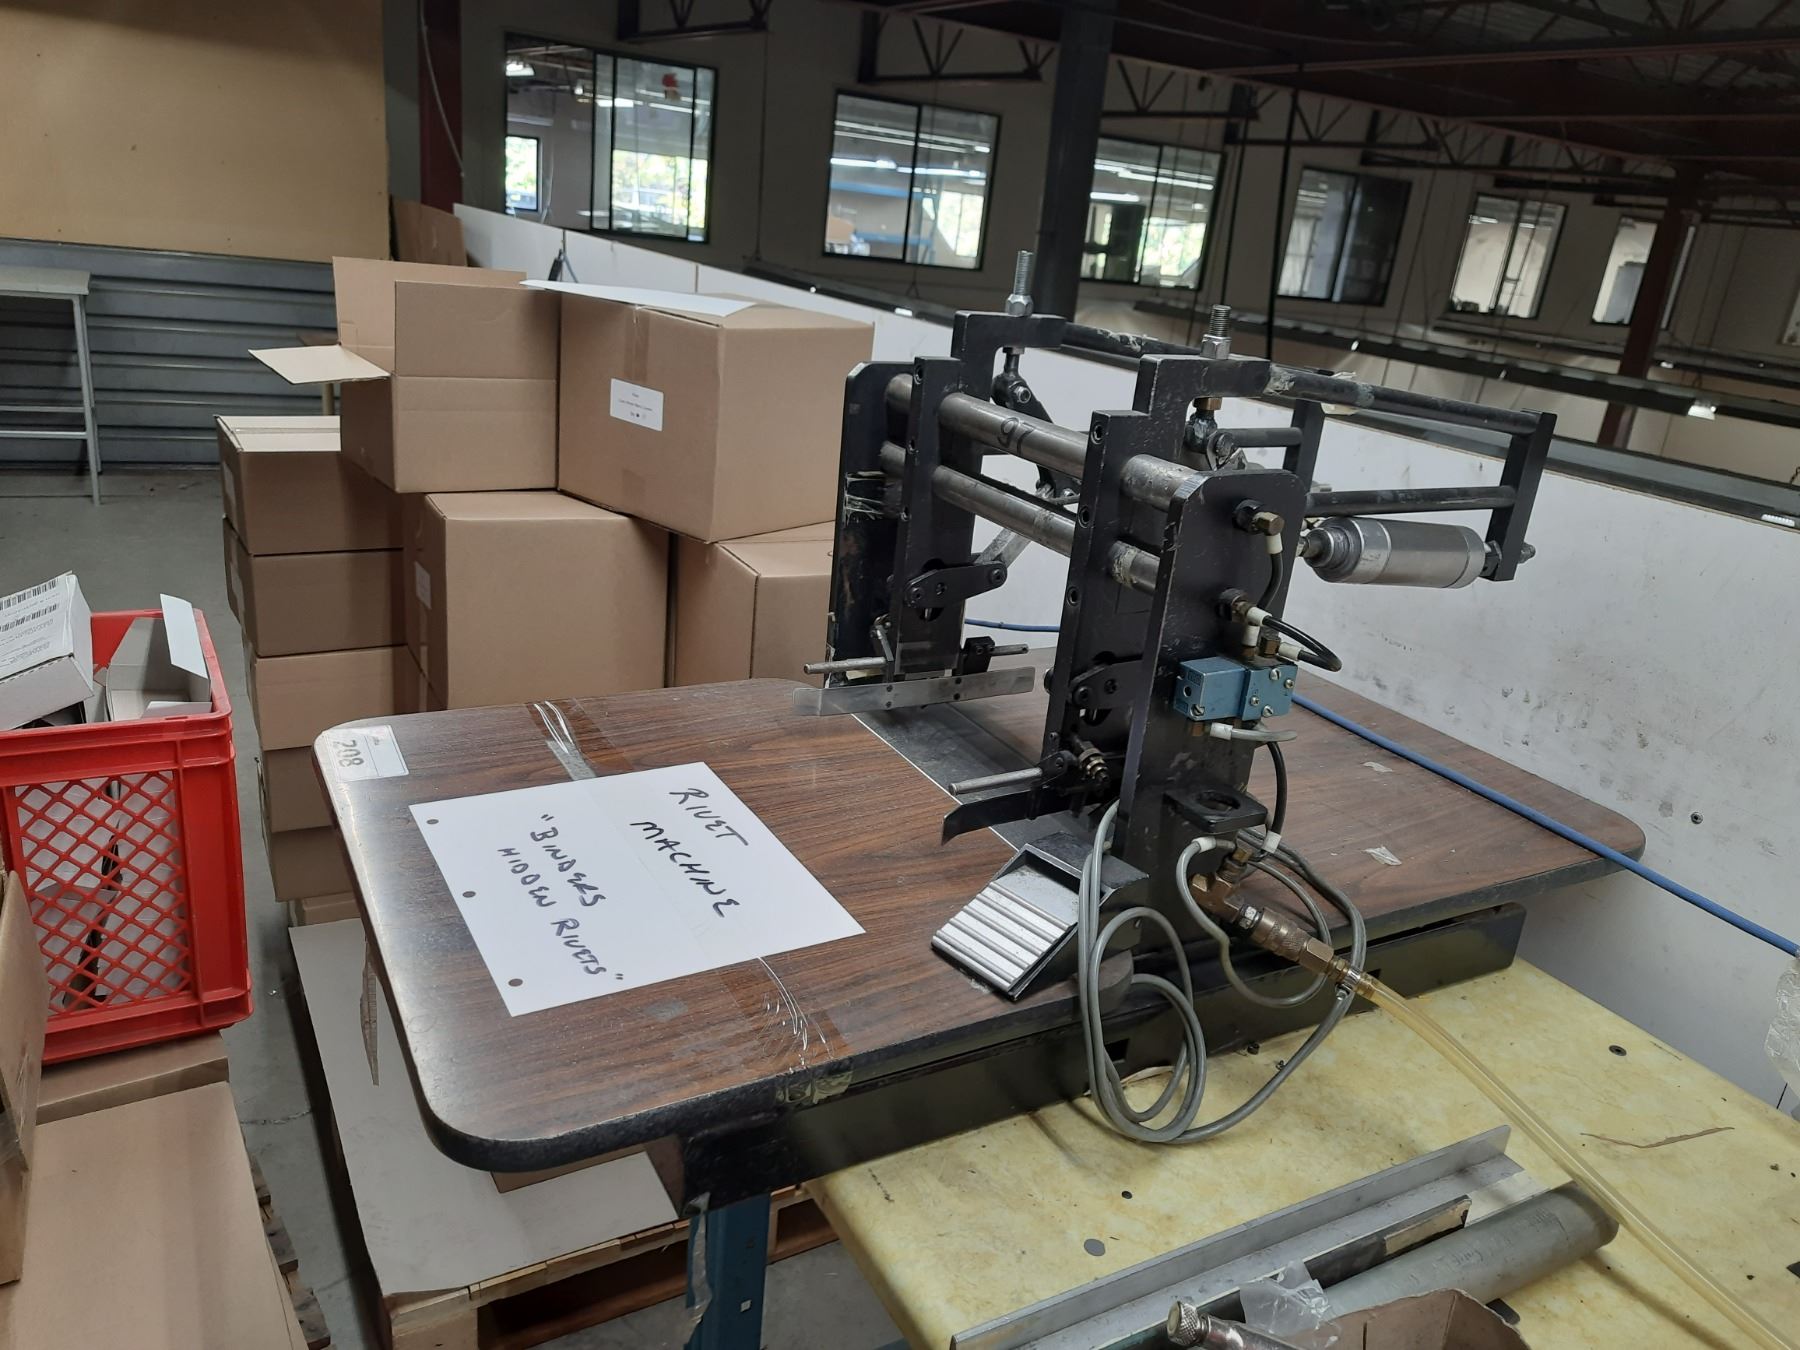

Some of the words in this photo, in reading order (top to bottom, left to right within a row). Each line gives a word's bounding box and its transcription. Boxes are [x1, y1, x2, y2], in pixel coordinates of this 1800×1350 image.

[333, 739, 365, 768] 208
[669, 788, 749, 846] RIVET
[497, 848, 557, 907] HIDDEN
[629, 821, 741, 918] MACHINE
